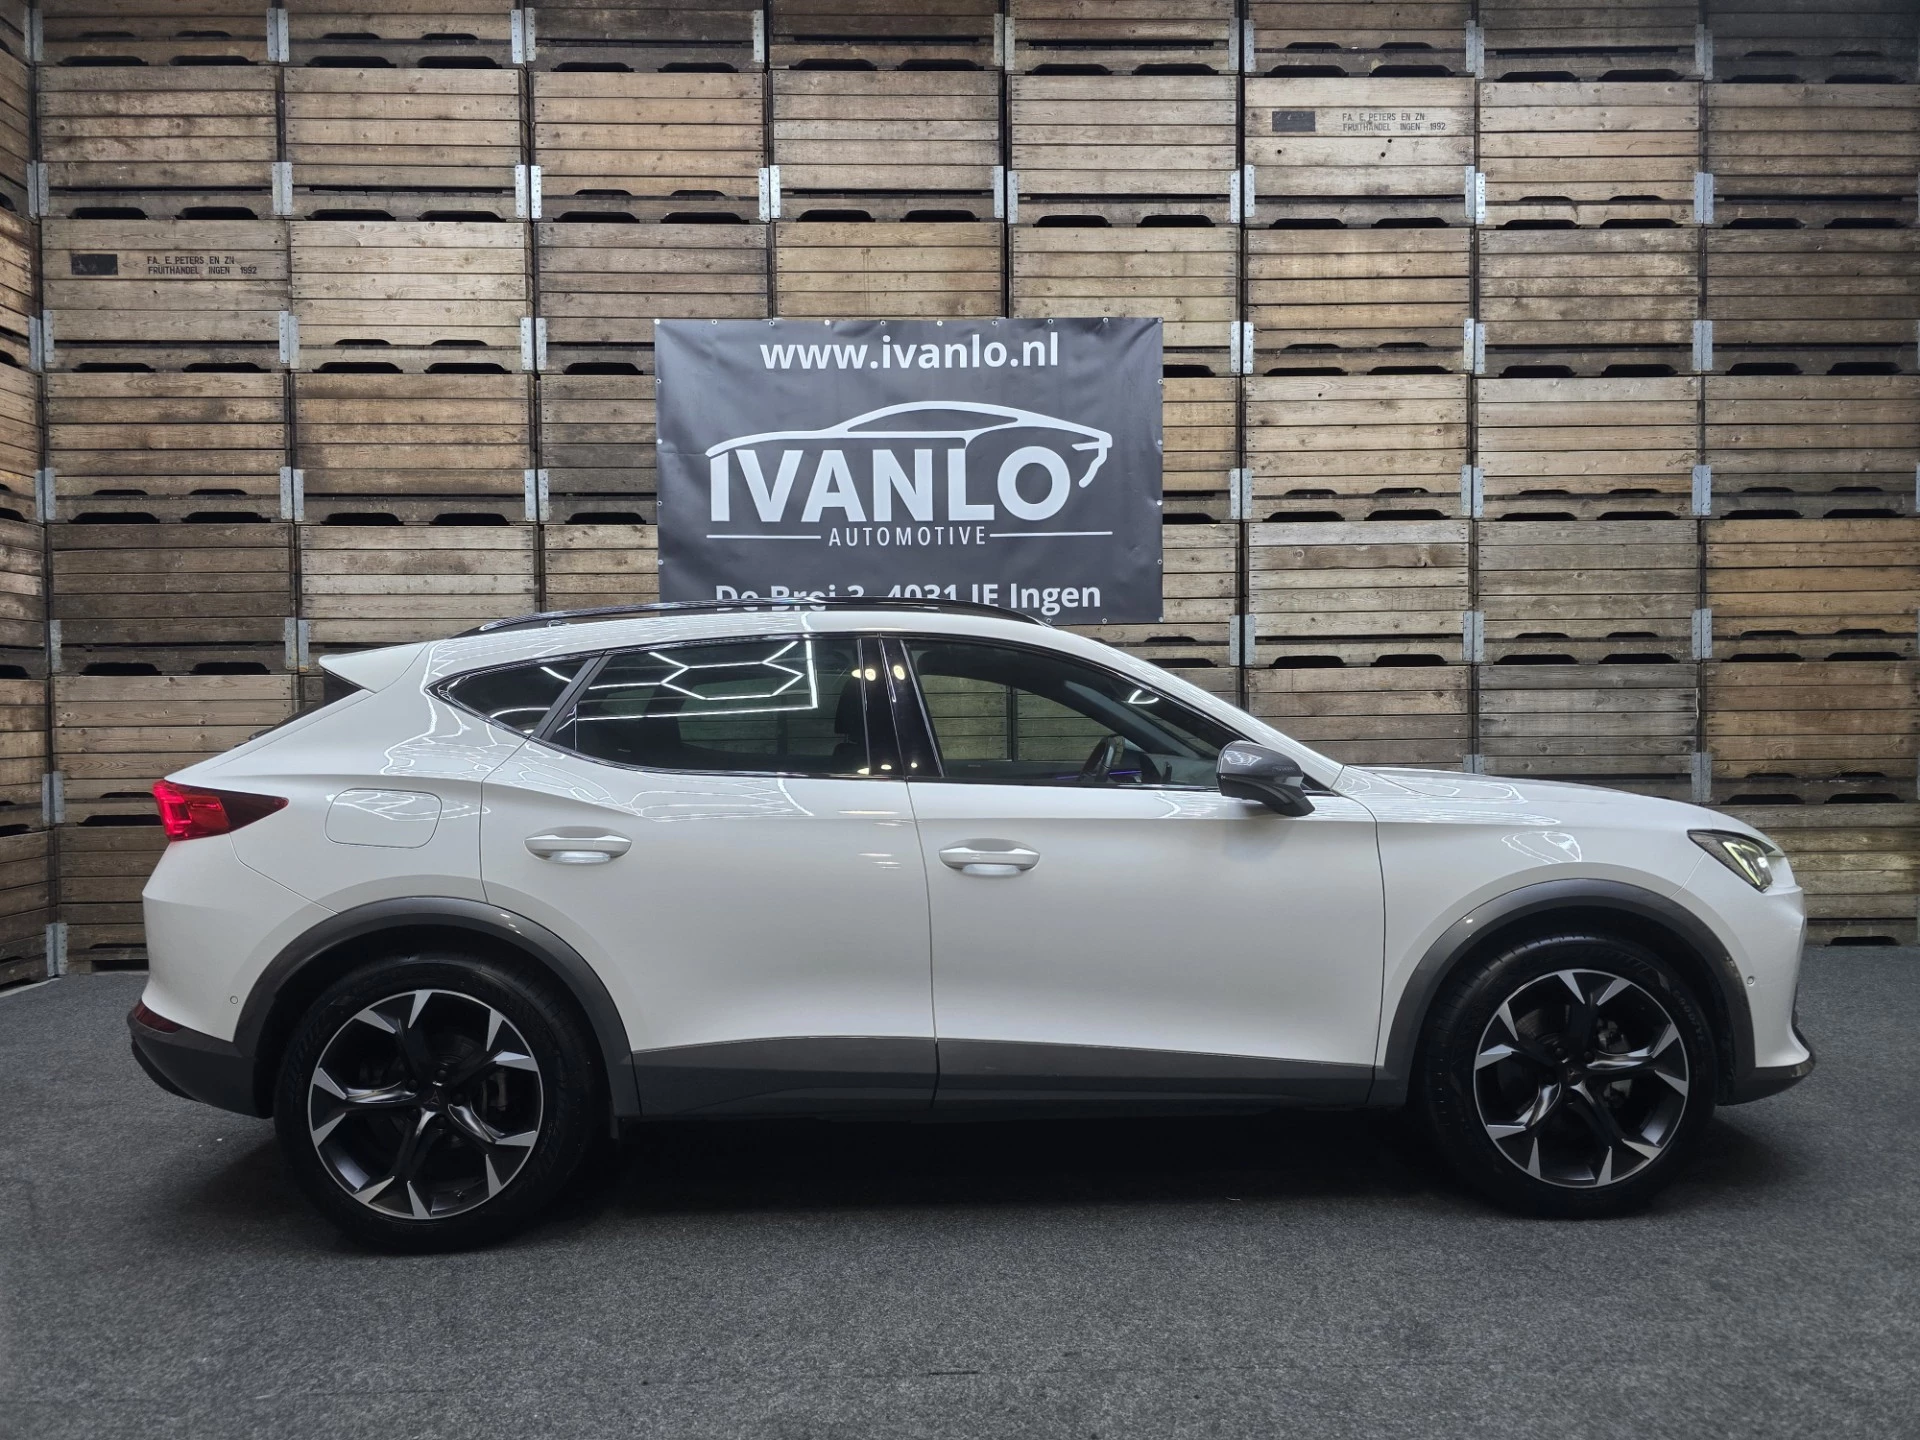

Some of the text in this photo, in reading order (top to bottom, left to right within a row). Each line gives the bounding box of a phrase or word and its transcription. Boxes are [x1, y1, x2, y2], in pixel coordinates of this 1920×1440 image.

[1368, 113, 1397, 121] PETERS
[1401, 113, 1411, 121] EN
[1415, 113, 1425, 121] ZN
[1342, 122, 1446, 131] FRUITHANDEL INGEN 1992
[175, 256, 204, 264] PETERS
[209, 256, 220, 265] EN
[224, 256, 235, 265] ZN
[148, 265, 257, 275] FRUITHANDEL INGEN 1992
[759, 331, 1059, 370] www.ivanlo.nl
[709, 445, 1072, 523] IVANLO
[828, 525, 986, 547] AUTOMOTIVE
[1010, 583, 1101, 617] Ingen
